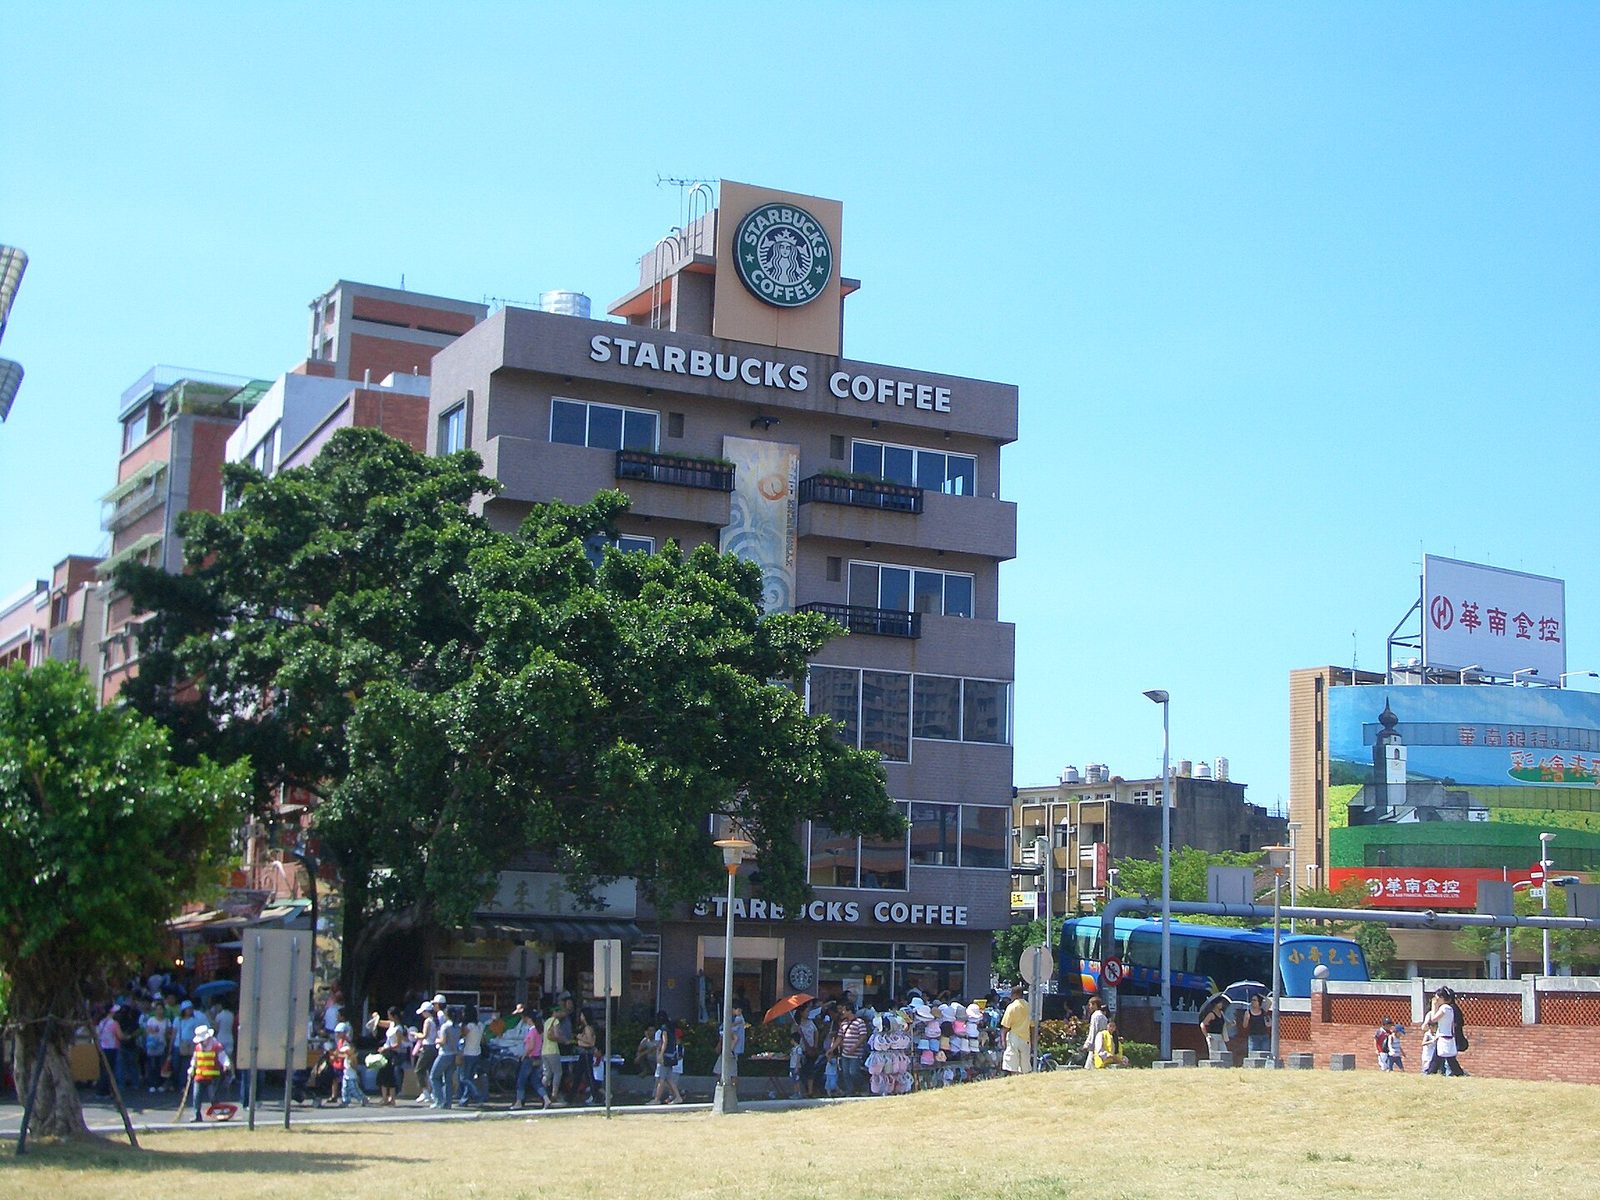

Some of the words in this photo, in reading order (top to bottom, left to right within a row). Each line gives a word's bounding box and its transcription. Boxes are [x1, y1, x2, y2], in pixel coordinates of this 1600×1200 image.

[744, 209, 827, 258] STARBUCKS
[751, 269, 816, 301] COFFEE
[590, 335, 809, 392] STARBUCKS
[829, 371, 951, 413] COFFEE
[1459, 600, 1561, 643] 華南金控
[1385, 877, 1461, 894] 華南金控
[693, 895, 859, 922] STARBCKS
[874, 902, 968, 926] COFFEE
